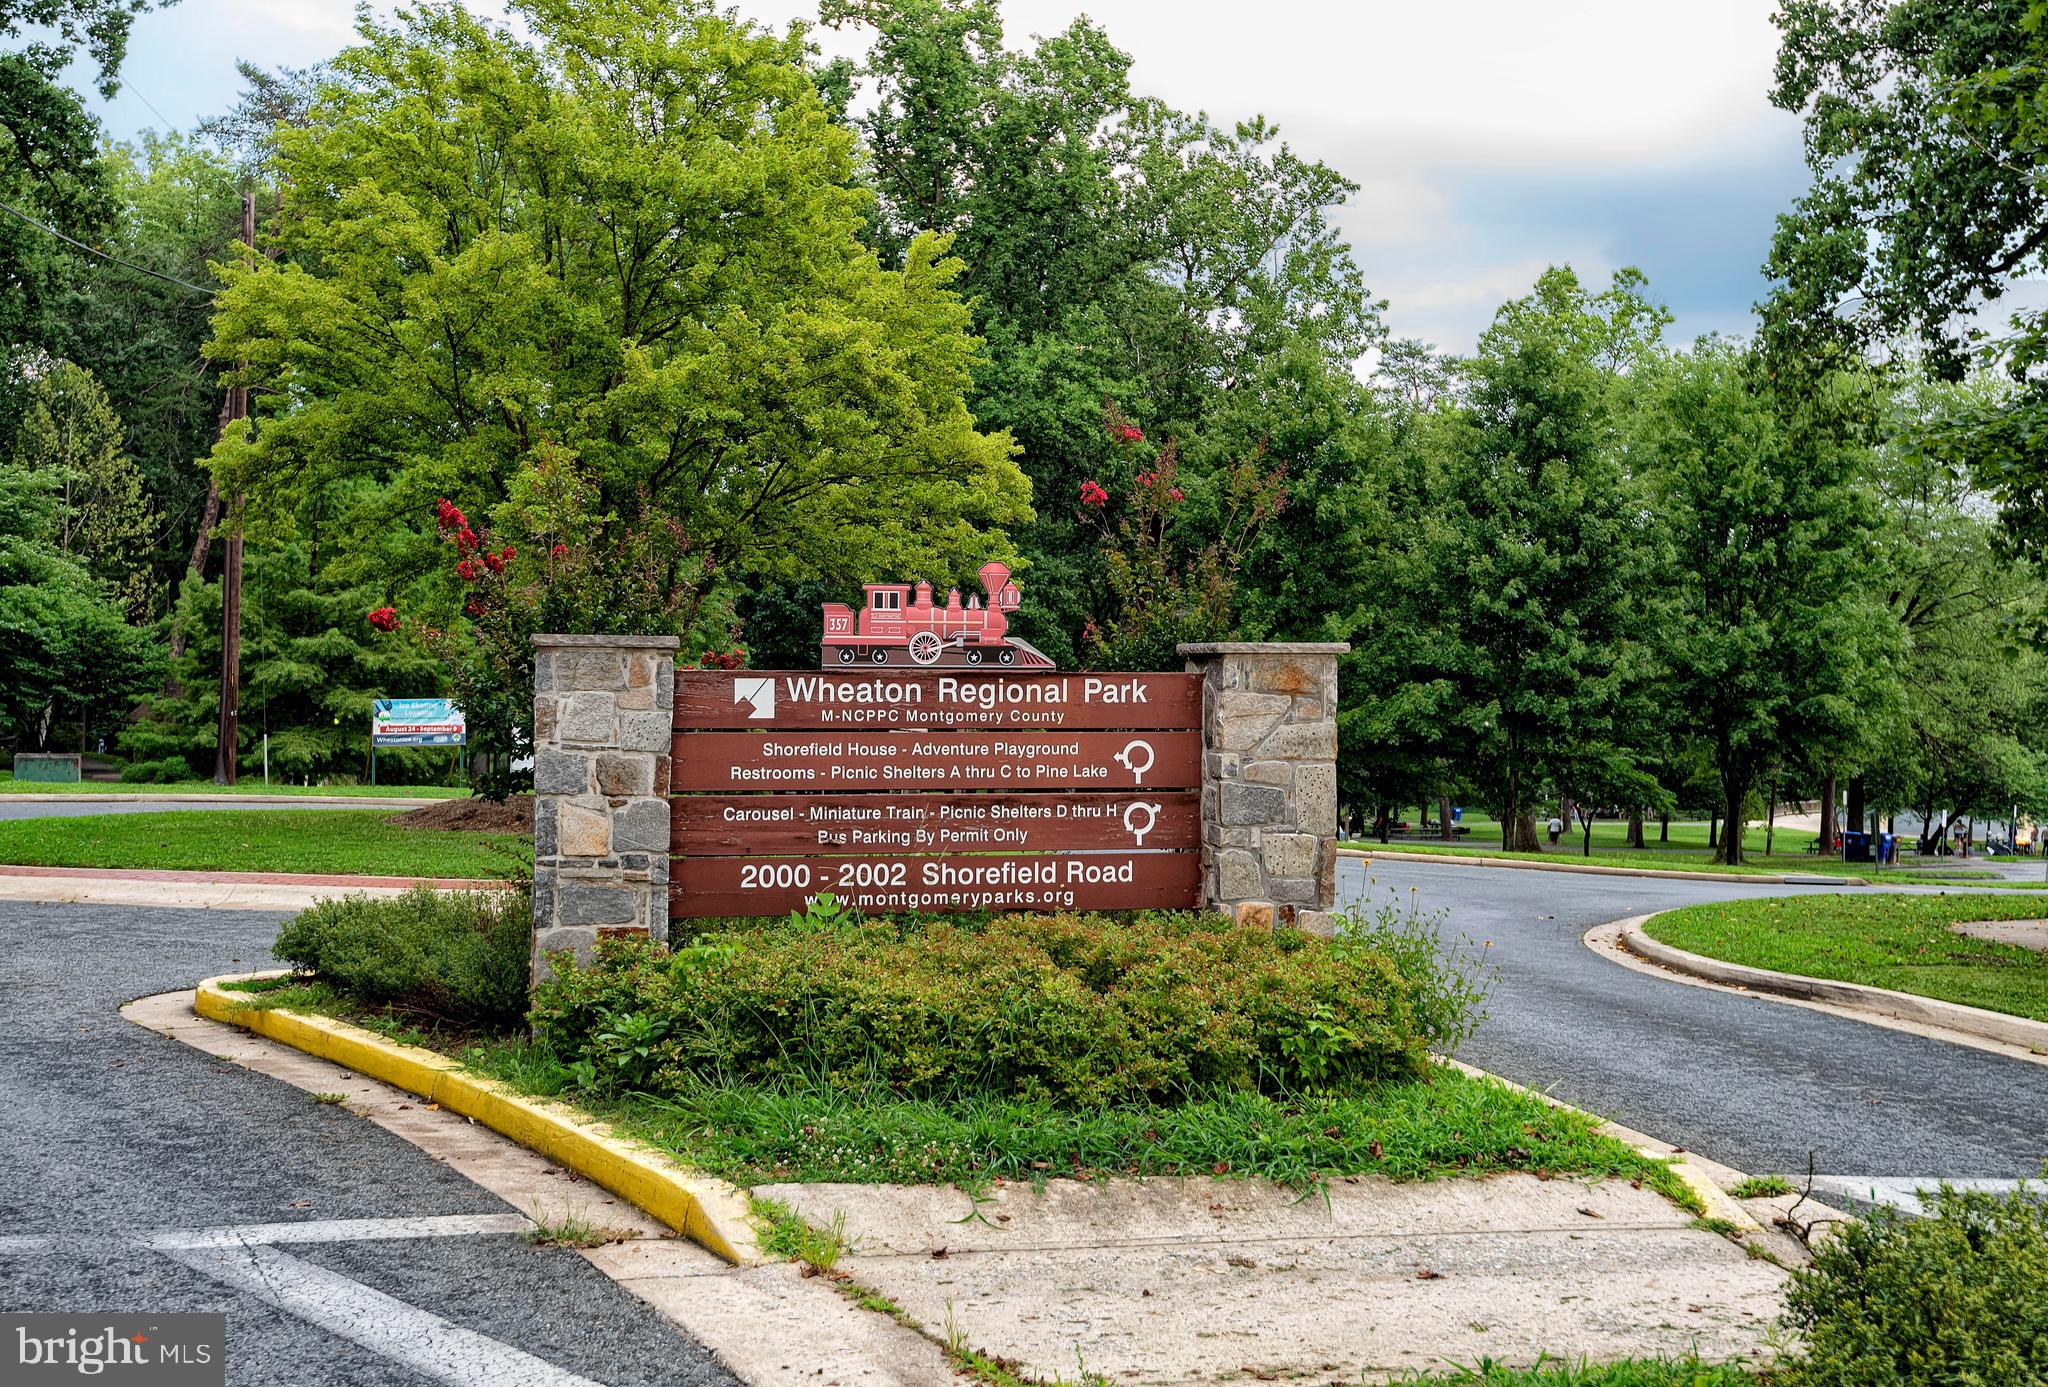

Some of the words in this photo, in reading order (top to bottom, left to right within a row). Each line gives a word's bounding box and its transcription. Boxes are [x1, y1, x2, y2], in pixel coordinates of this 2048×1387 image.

[829, 617, 849, 631] 357
[786, 676, 922, 704] Wheaton
[938, 677, 1068, 709] Regional
[1084, 677, 1148, 704] Park
[821, 709, 900, 723] M-NCPPC
[906, 708, 1004, 725] Montgomery
[1010, 709, 1065, 726] County
[419, 725, 453, 733] September
[762, 741, 842, 757] Shorefield
[847, 742, 897, 757] House
[911, 742, 990, 756] Adventure
[994, 741, 1080, 760] Playground
[730, 765, 816, 780] Restrooms
[831, 764, 878, 780] Picnic
[882, 764, 946, 780] Shelters
[949, 764, 961, 779] A
[964, 764, 996, 780] thru
[1000, 764, 1013, 779] C
[1015, 765, 1031, 779] to
[1036, 764, 1069, 779] Pine
[1073, 764, 1108, 779] Lake
[723, 806, 794, 822] Carousel
[810, 806, 882, 821] Miniature
[886, 805, 925, 821] Train
[940, 805, 986, 821] Picnic
[990, 804, 1052, 819] Shelters
[1056, 804, 1068, 818] D
[1071, 803, 1102, 819] thru
[1106, 803, 1118, 818] H
[817, 829, 847, 844] Bus
[852, 828, 911, 847] Parking
[915, 827, 935, 846] By
[940, 827, 989, 844] Permit
[993, 825, 1028, 846] Only
[740, 863, 811, 889] 2000
[838, 862, 907, 888] 2002
[922, 860, 1057, 886] Shorefield
[1067, 859, 1134, 884] Road
[804, 888, 1075, 909] ww.montgomeryparks.org
